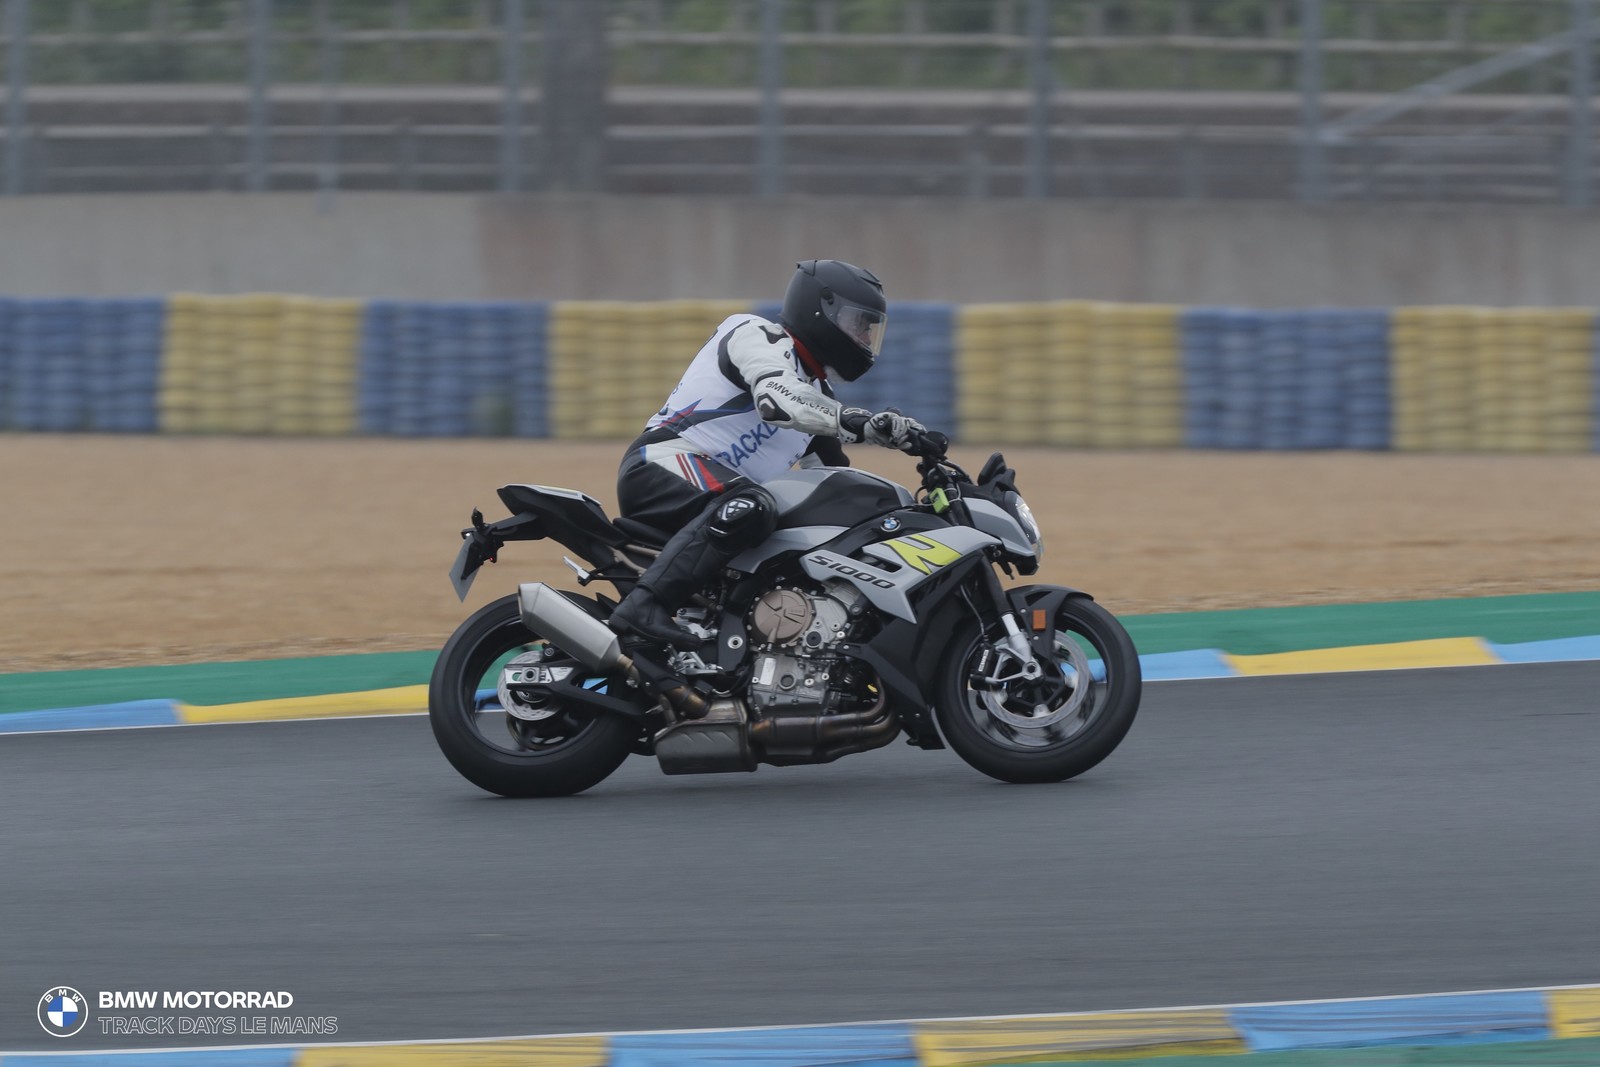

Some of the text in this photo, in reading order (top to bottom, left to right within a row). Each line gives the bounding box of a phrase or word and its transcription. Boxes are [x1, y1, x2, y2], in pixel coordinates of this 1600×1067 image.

[765, 381, 836, 417] BMW Moorra
[808, 555, 896, 589] S1000
